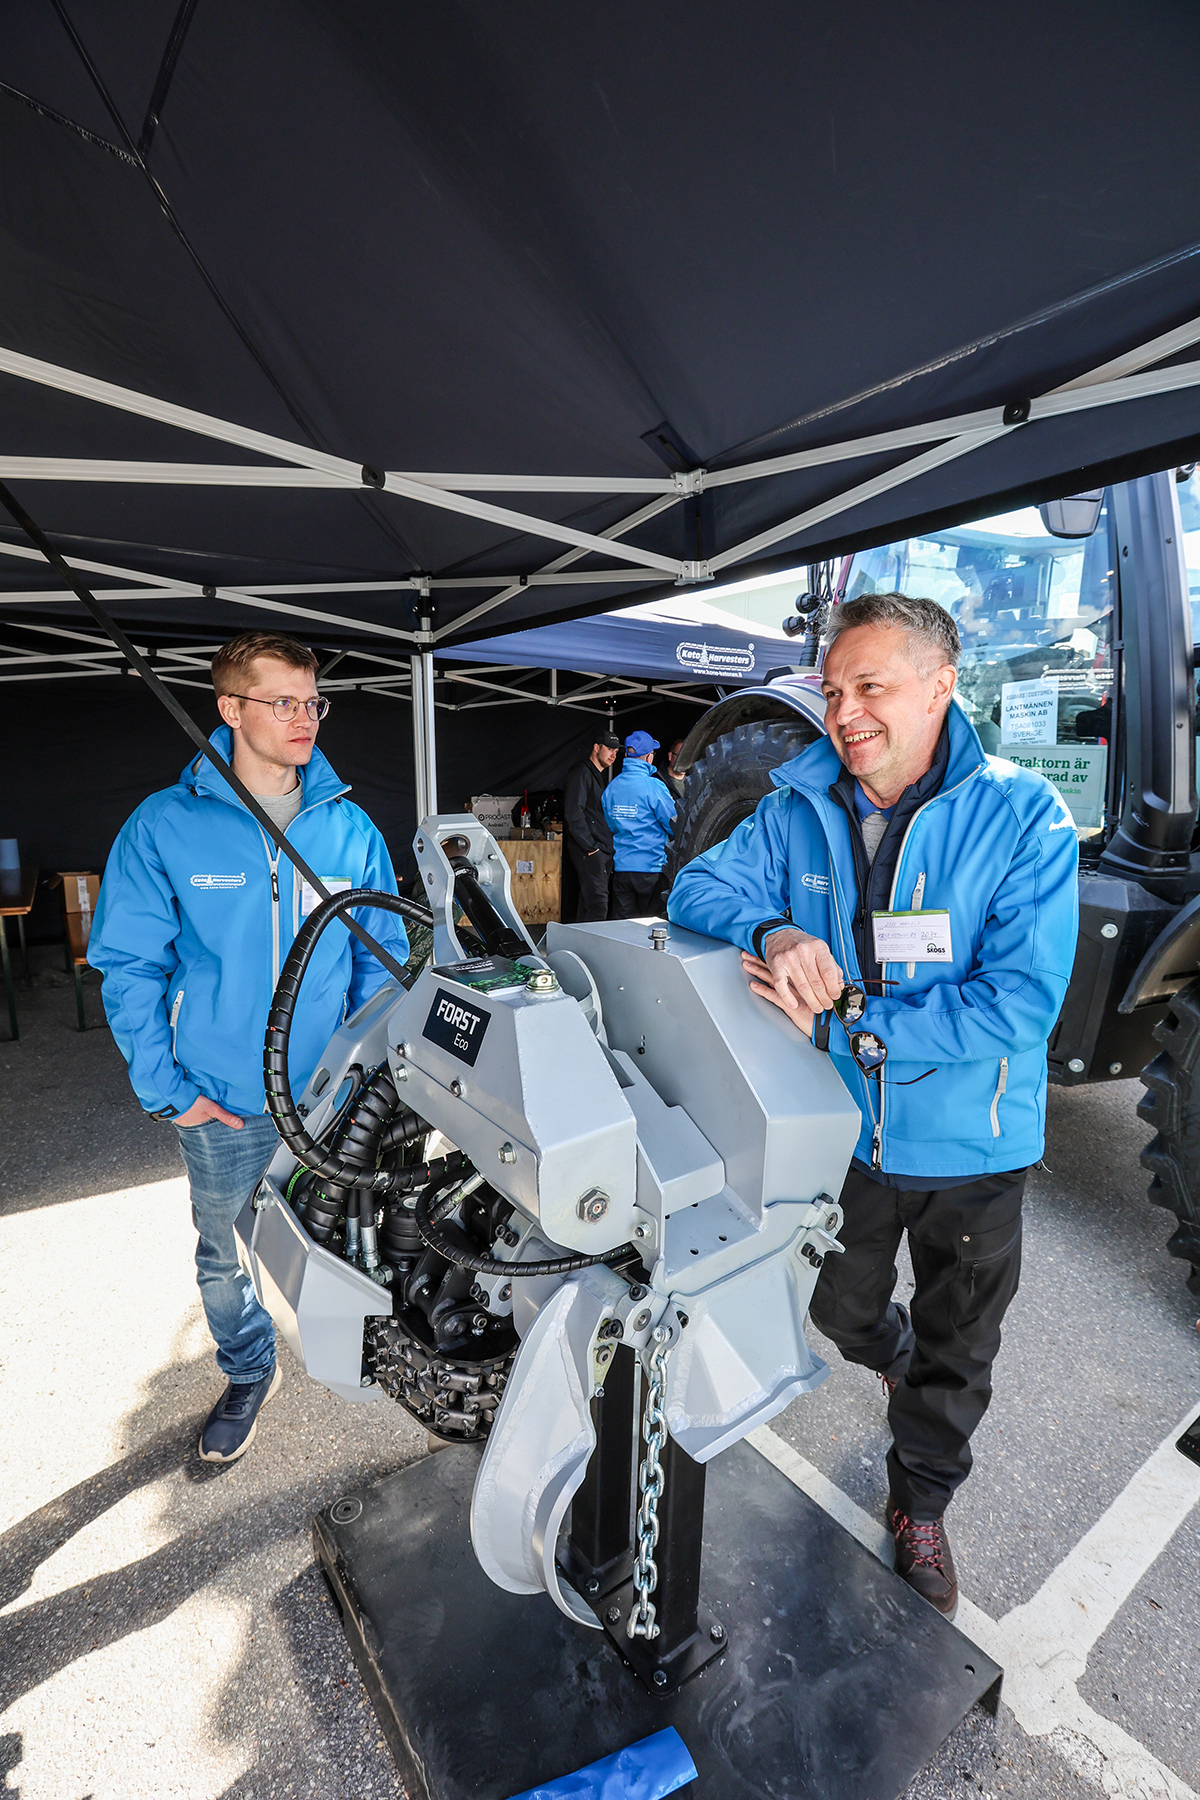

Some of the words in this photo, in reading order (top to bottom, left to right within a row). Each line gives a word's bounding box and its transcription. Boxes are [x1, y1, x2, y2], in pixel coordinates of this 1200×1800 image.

[682, 649, 700, 659] Keto
[709, 653, 750, 664] Harvesters
[1006, 701, 1054, 712] LANTMÄNNEN
[1009, 710, 1036, 719] MASKIN
[1013, 730, 1043, 738] SVERIGE
[1010, 756, 1070, 769] Traktorn
[1074, 758, 1090, 770] är
[1071, 774, 1088, 783] av
[436, 999, 480, 1035] FORST
[454, 1032, 469, 1051] Eco
